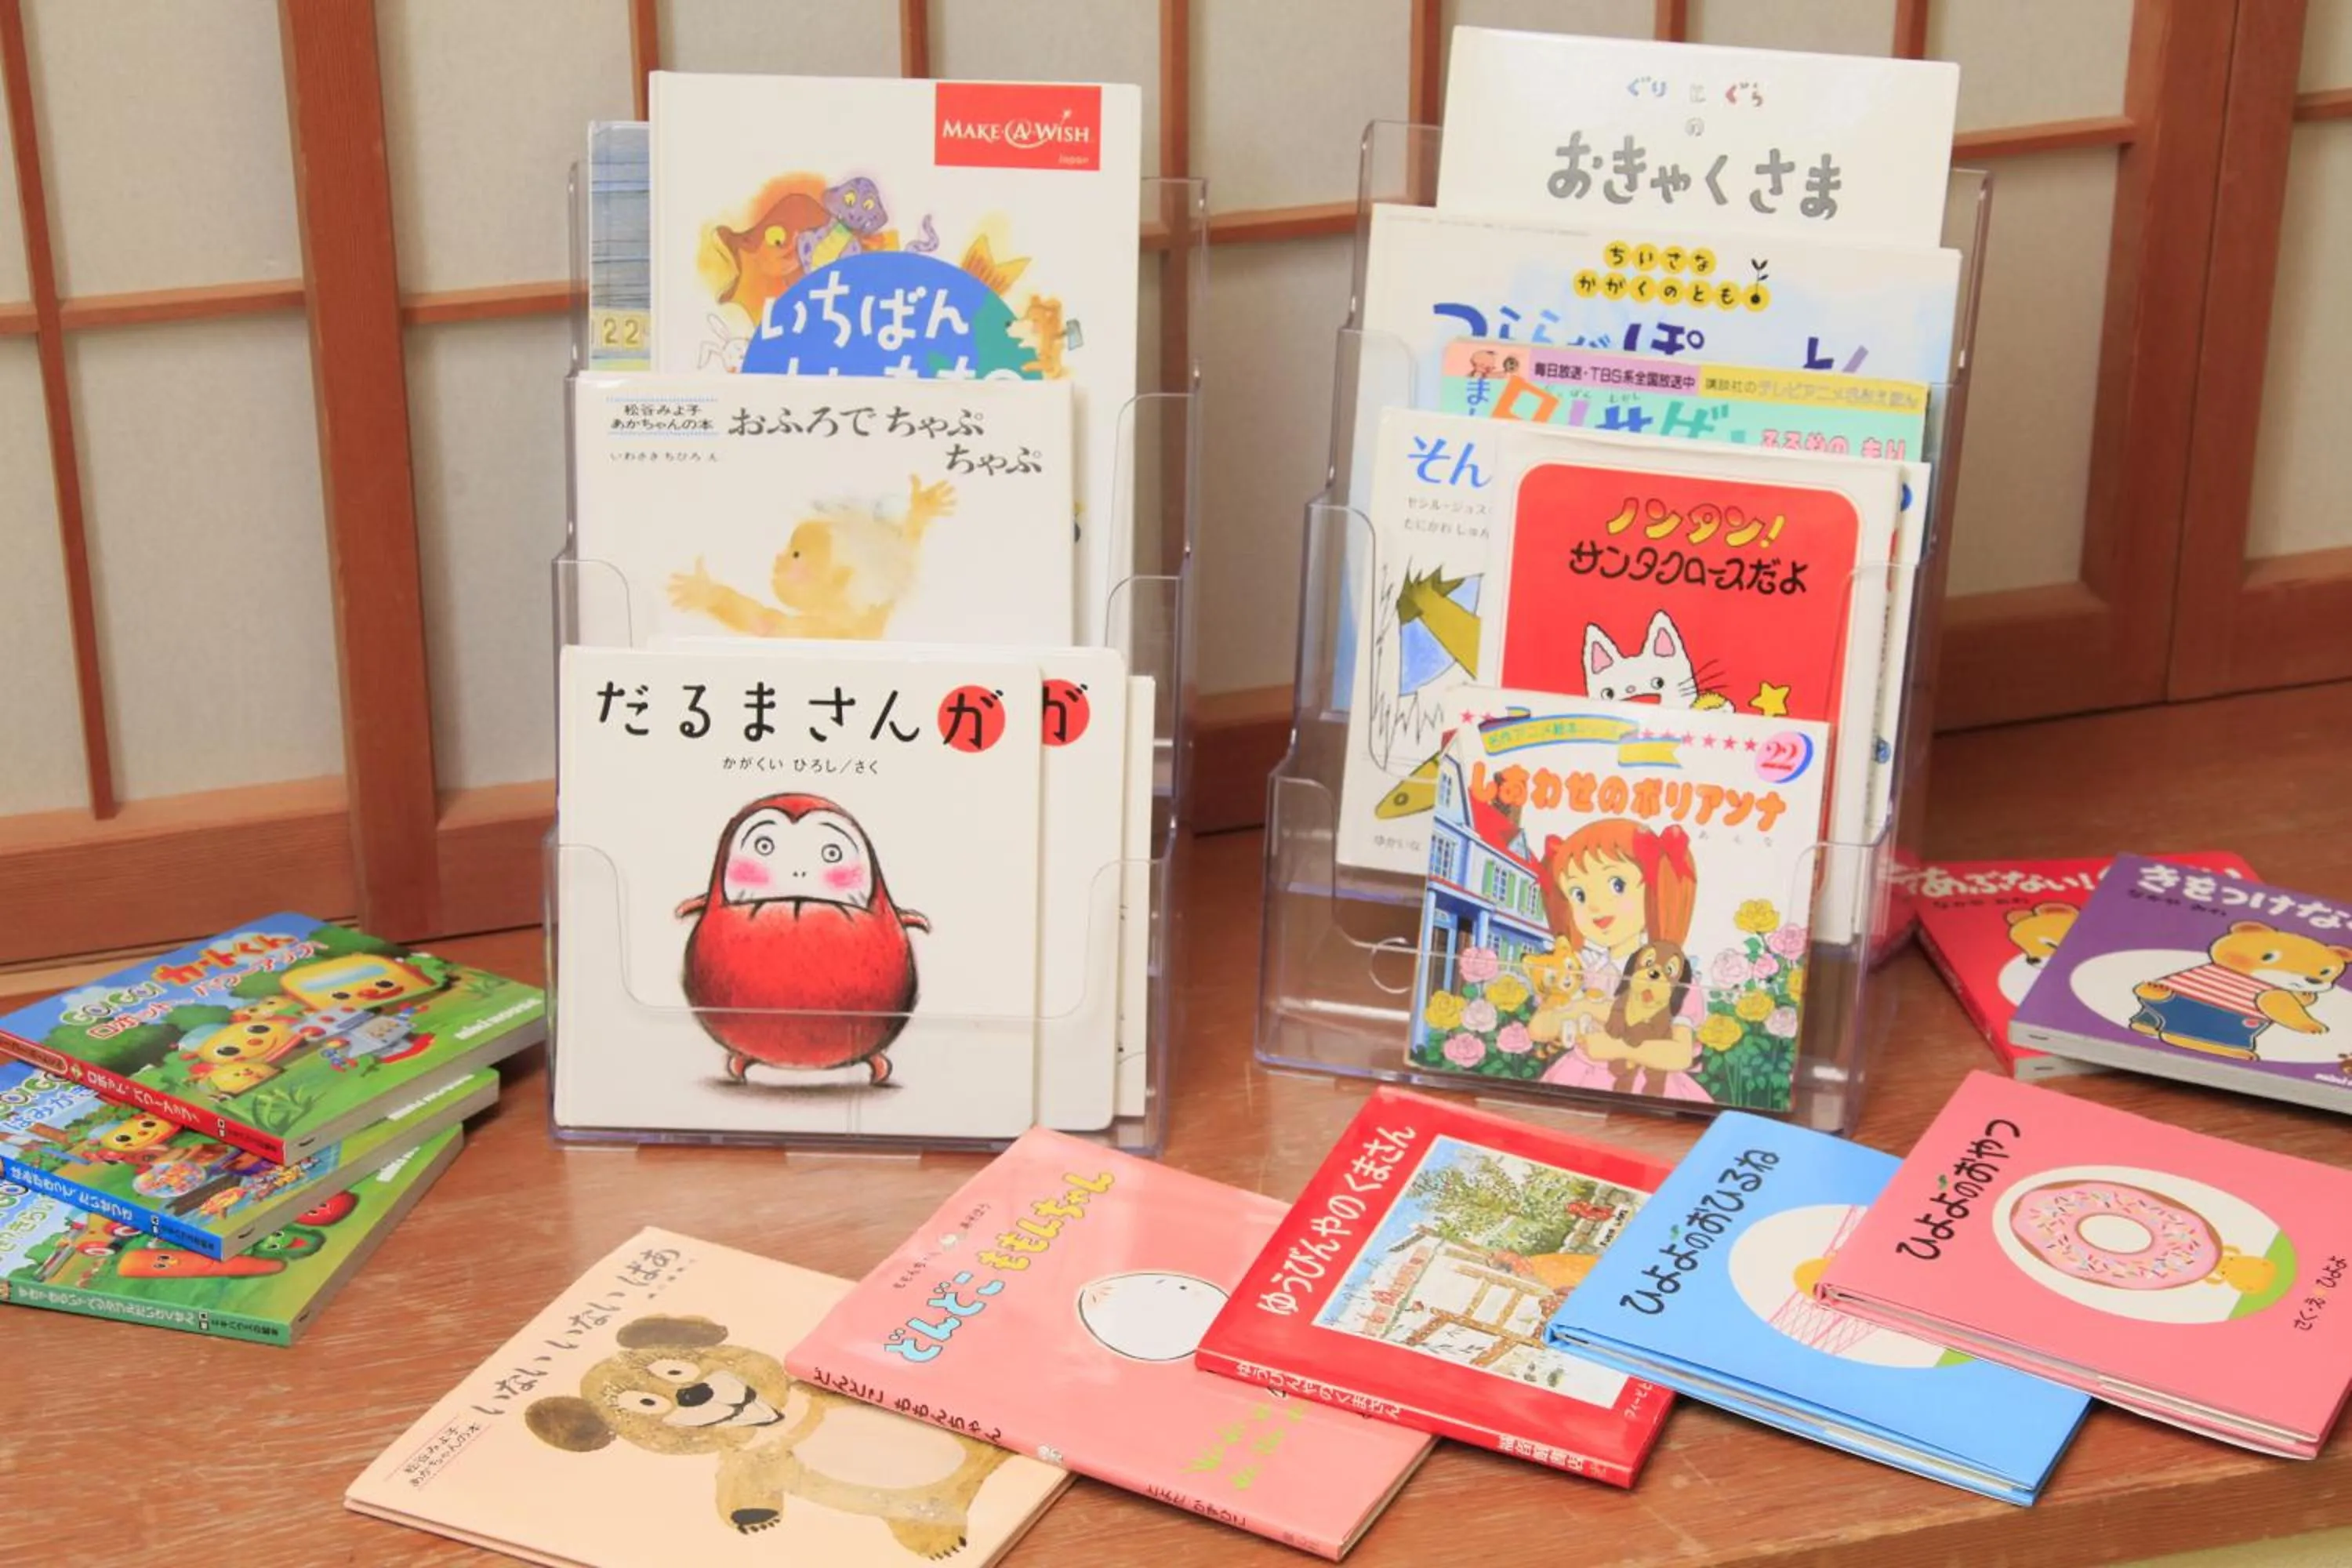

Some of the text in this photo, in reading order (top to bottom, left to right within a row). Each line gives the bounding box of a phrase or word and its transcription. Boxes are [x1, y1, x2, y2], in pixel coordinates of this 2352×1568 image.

[1627, 76, 1668, 97] ぐり
[1725, 82, 1763, 107] ぐら
[942, 118, 1001, 143] MAKE
[1034, 121, 1090, 143] WISH
[1684, 116, 1705, 137] の
[1547, 132, 1842, 220] おきゃくさま
[1609, 245, 1710, 274] ちいさな
[760, 270, 970, 350] いちばん
[1578, 275, 1735, 306] かがくのとも
[610, 417, 715, 431] あかちゃんの本
[623, 403, 702, 417] 松谷みよ子
[728, 405, 985, 438] おふろでちゃぷ
[945, 445, 1043, 475] ちゃぷ
[1407, 436, 1493, 488] そん
[1570, 541, 1809, 596] サンタクロースだよ
[596, 681, 1004, 750] だるまさんが
[1042, 683, 1089, 742] が
[723, 756, 784, 771] かがくい
[1761, 741, 1798, 771] 22
[1468, 762, 1788, 832] しあわせのポリアンナ
[2137, 864, 2352, 931] きをつけな
[152, 933, 299, 986] カートくん
[1895, 1119, 2023, 1262] ひよよのおやつ
[1256, 1125, 1416, 1317] ゆうびんやのくまさん
[1621, 1148, 1781, 1317] ひよよのおひるね
[884, 1171, 1115, 1364] どんどこ ももんちゃん
[471, 1353, 549, 1416] いない
[546, 1290, 626, 1351] いない
[624, 1247, 682, 1287] ばあ
